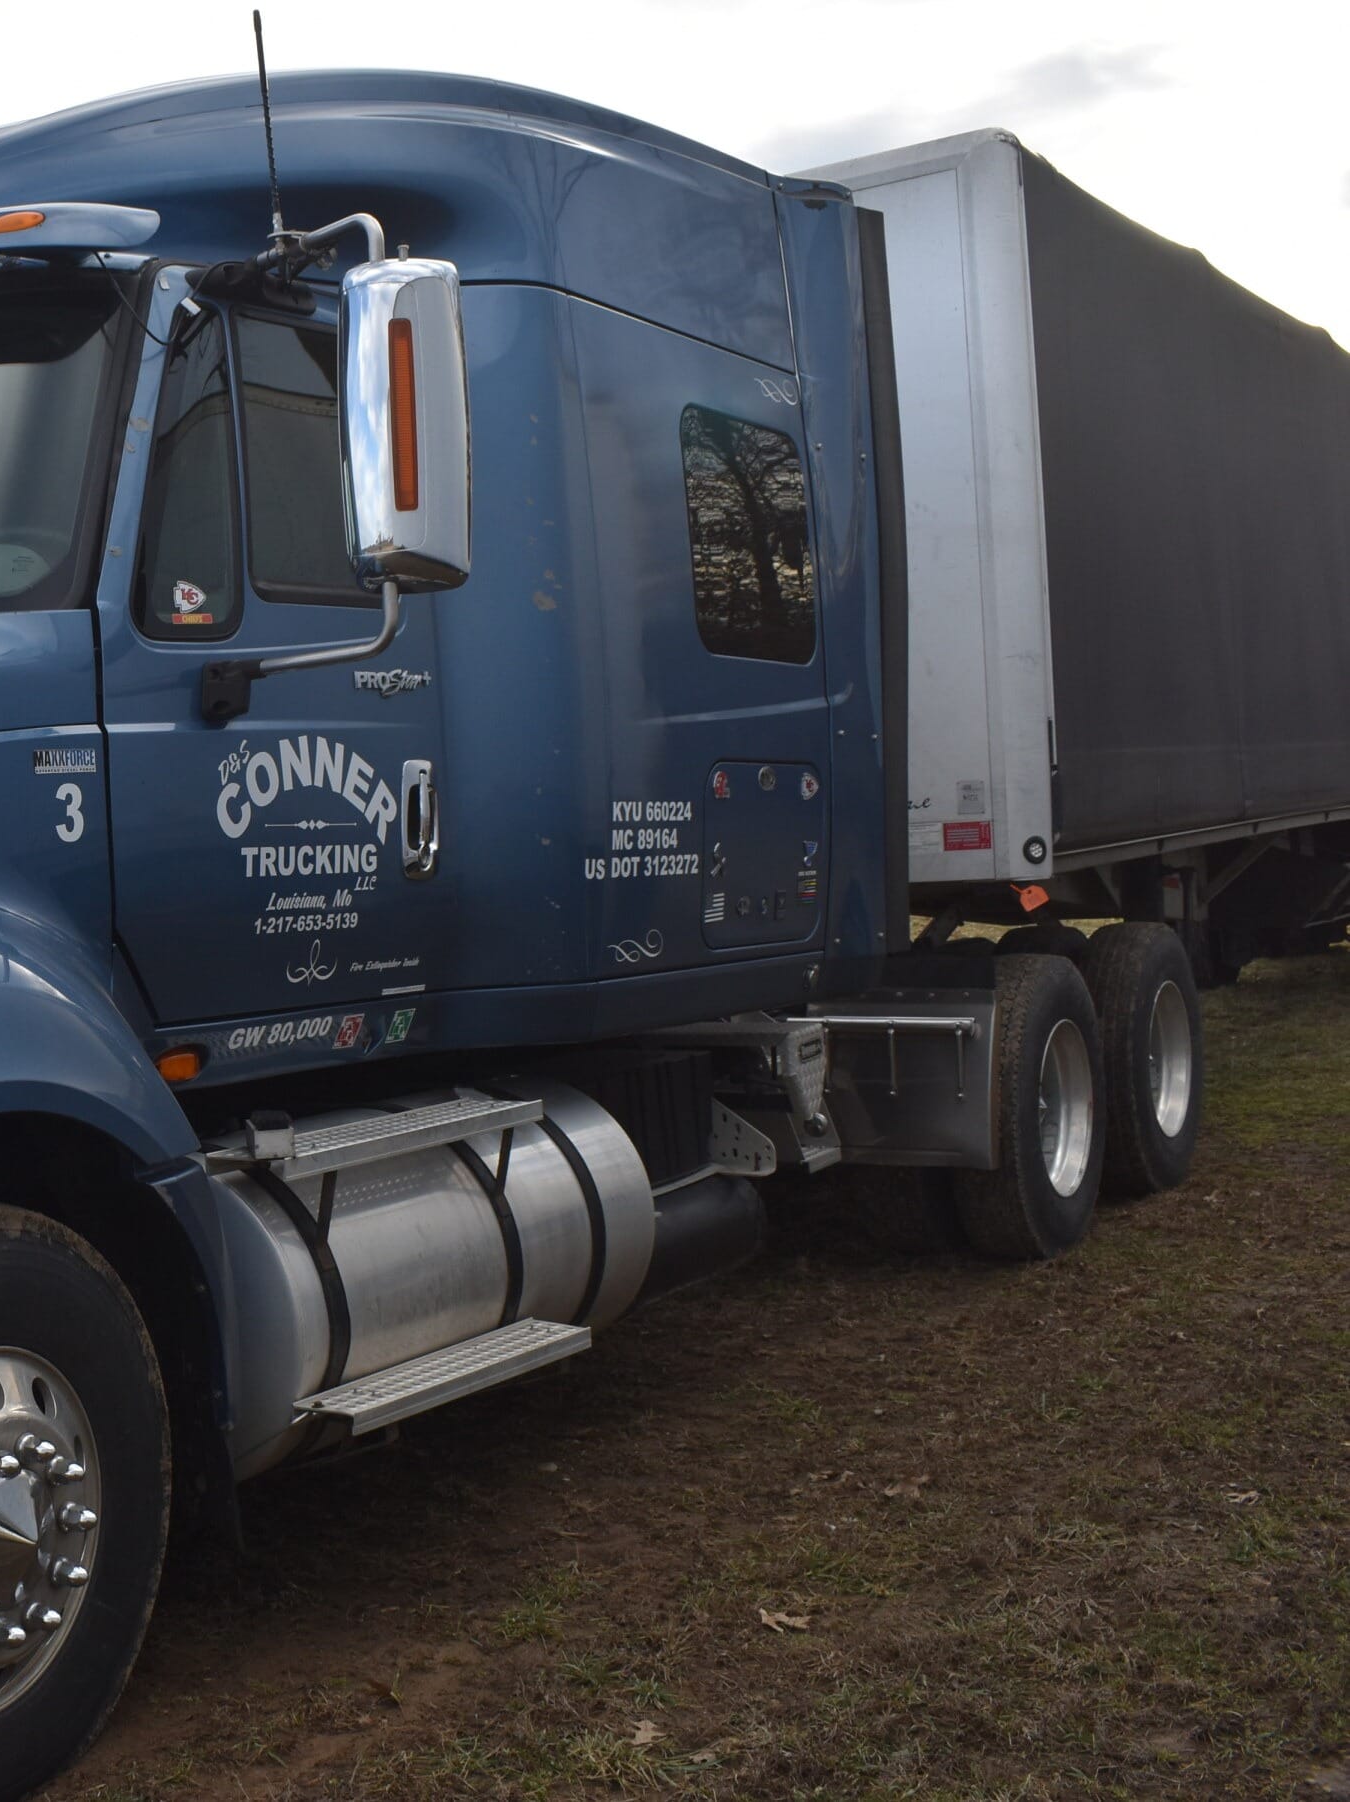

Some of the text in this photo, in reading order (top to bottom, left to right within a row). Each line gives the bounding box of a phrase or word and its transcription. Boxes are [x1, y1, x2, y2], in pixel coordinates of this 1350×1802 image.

[34, 750, 96, 767] MAXXFORCE
[218, 740, 250, 786] D&S
[217, 735, 398, 845] CONNER
[56, 783, 84, 842] 3
[613, 801, 692, 821] KYU 660224
[612, 828, 678, 850] MC 89164
[241, 844, 377, 877] TRUCKING
[585, 854, 699, 880] US DOT 3123272
[354, 876, 377, 891] LLC
[266, 888, 352, 911] Louisiana, Mo
[254, 912, 359, 934] 1-217-653-5139
[228, 1025, 266, 1050] GW
[267, 1016, 332, 1045] 80,000
